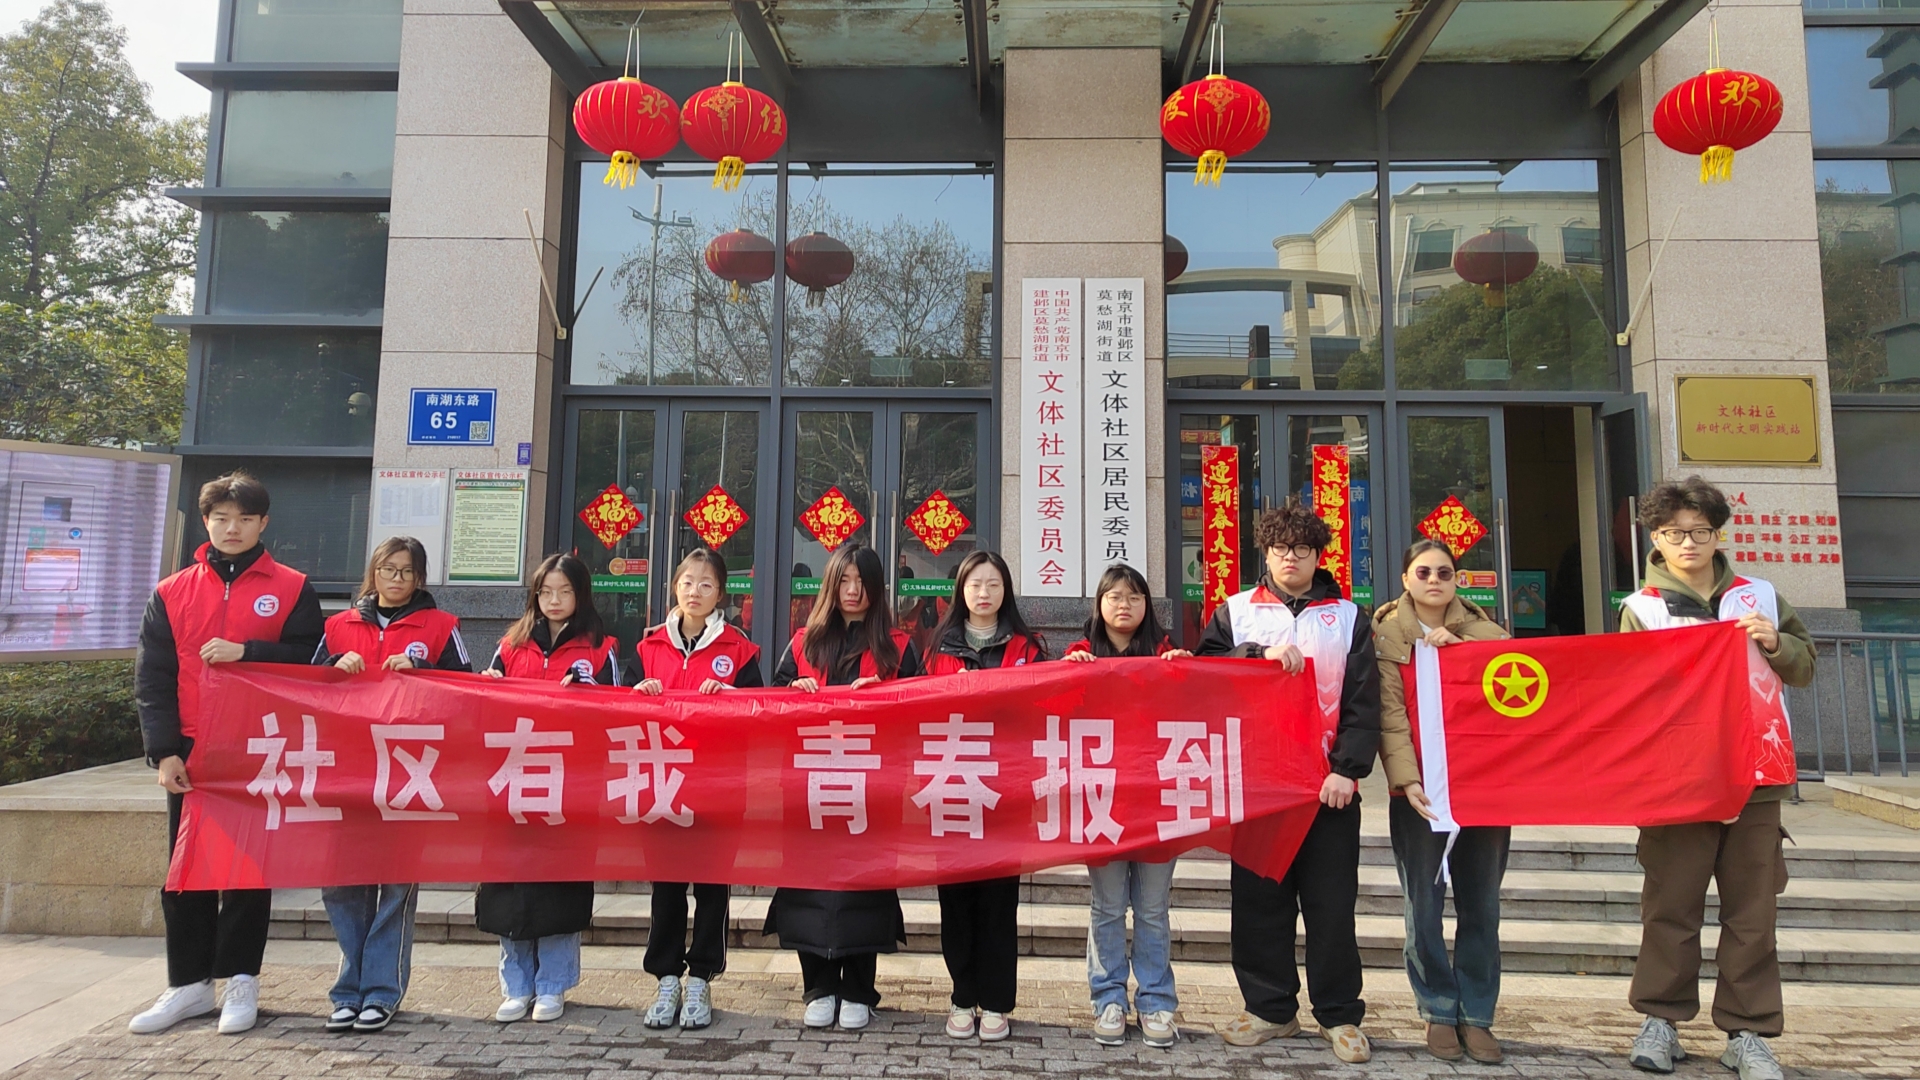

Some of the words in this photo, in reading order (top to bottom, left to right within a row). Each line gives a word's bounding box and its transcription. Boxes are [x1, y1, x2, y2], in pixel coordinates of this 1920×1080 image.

[1719, 75, 1761, 108] 欢
[637, 90, 670, 124] 欢
[1033, 289, 1049, 362] 建邺区莫愁湖街道
[1054, 289, 1070, 362] 中国共产党南京市
[1096, 289, 1113, 362] 莫愁湖街道
[1117, 289, 1133, 362] 南京市建邺区
[426, 393, 480, 406] 南湖东路
[1718, 404, 1777, 418] 文体社区
[430, 411, 457, 429] 65
[1696, 421, 1801, 435] 新时代文明实践站
[379, 471, 446, 479] 文体社区宣传公示栏
[458, 472, 524, 480] 文体社区宣传公示栏
[1036, 370, 1066, 585] 文体社区委员会
[1100, 370, 1130, 561] 文体社区居民委员
[598, 493, 626, 523] 福
[702, 494, 731, 524] 福
[818, 496, 847, 526] 福
[923, 500, 952, 529] 福
[1437, 505, 1468, 536] 福
[1761, 514, 1782, 526] 民主
[1788, 515, 1810, 526] 文明
[1816, 515, 1837, 527] 和谐
[1209, 460, 1235, 607] 迎新春大吉大
[1734, 532, 1755, 544] 自由
[1761, 532, 1783, 544] 平等
[1788, 533, 1811, 545] 公正
[1816, 534, 1839, 545] 法治
[1763, 552, 1785, 563] 敬业
[1790, 553, 1812, 564] 诚信
[1818, 553, 1840, 564] 友善
[591, 580, 646, 588] 社区新时代文明实践站
[246, 711, 695, 830] 社区有我
[793, 713, 1245, 846] 青春报到
